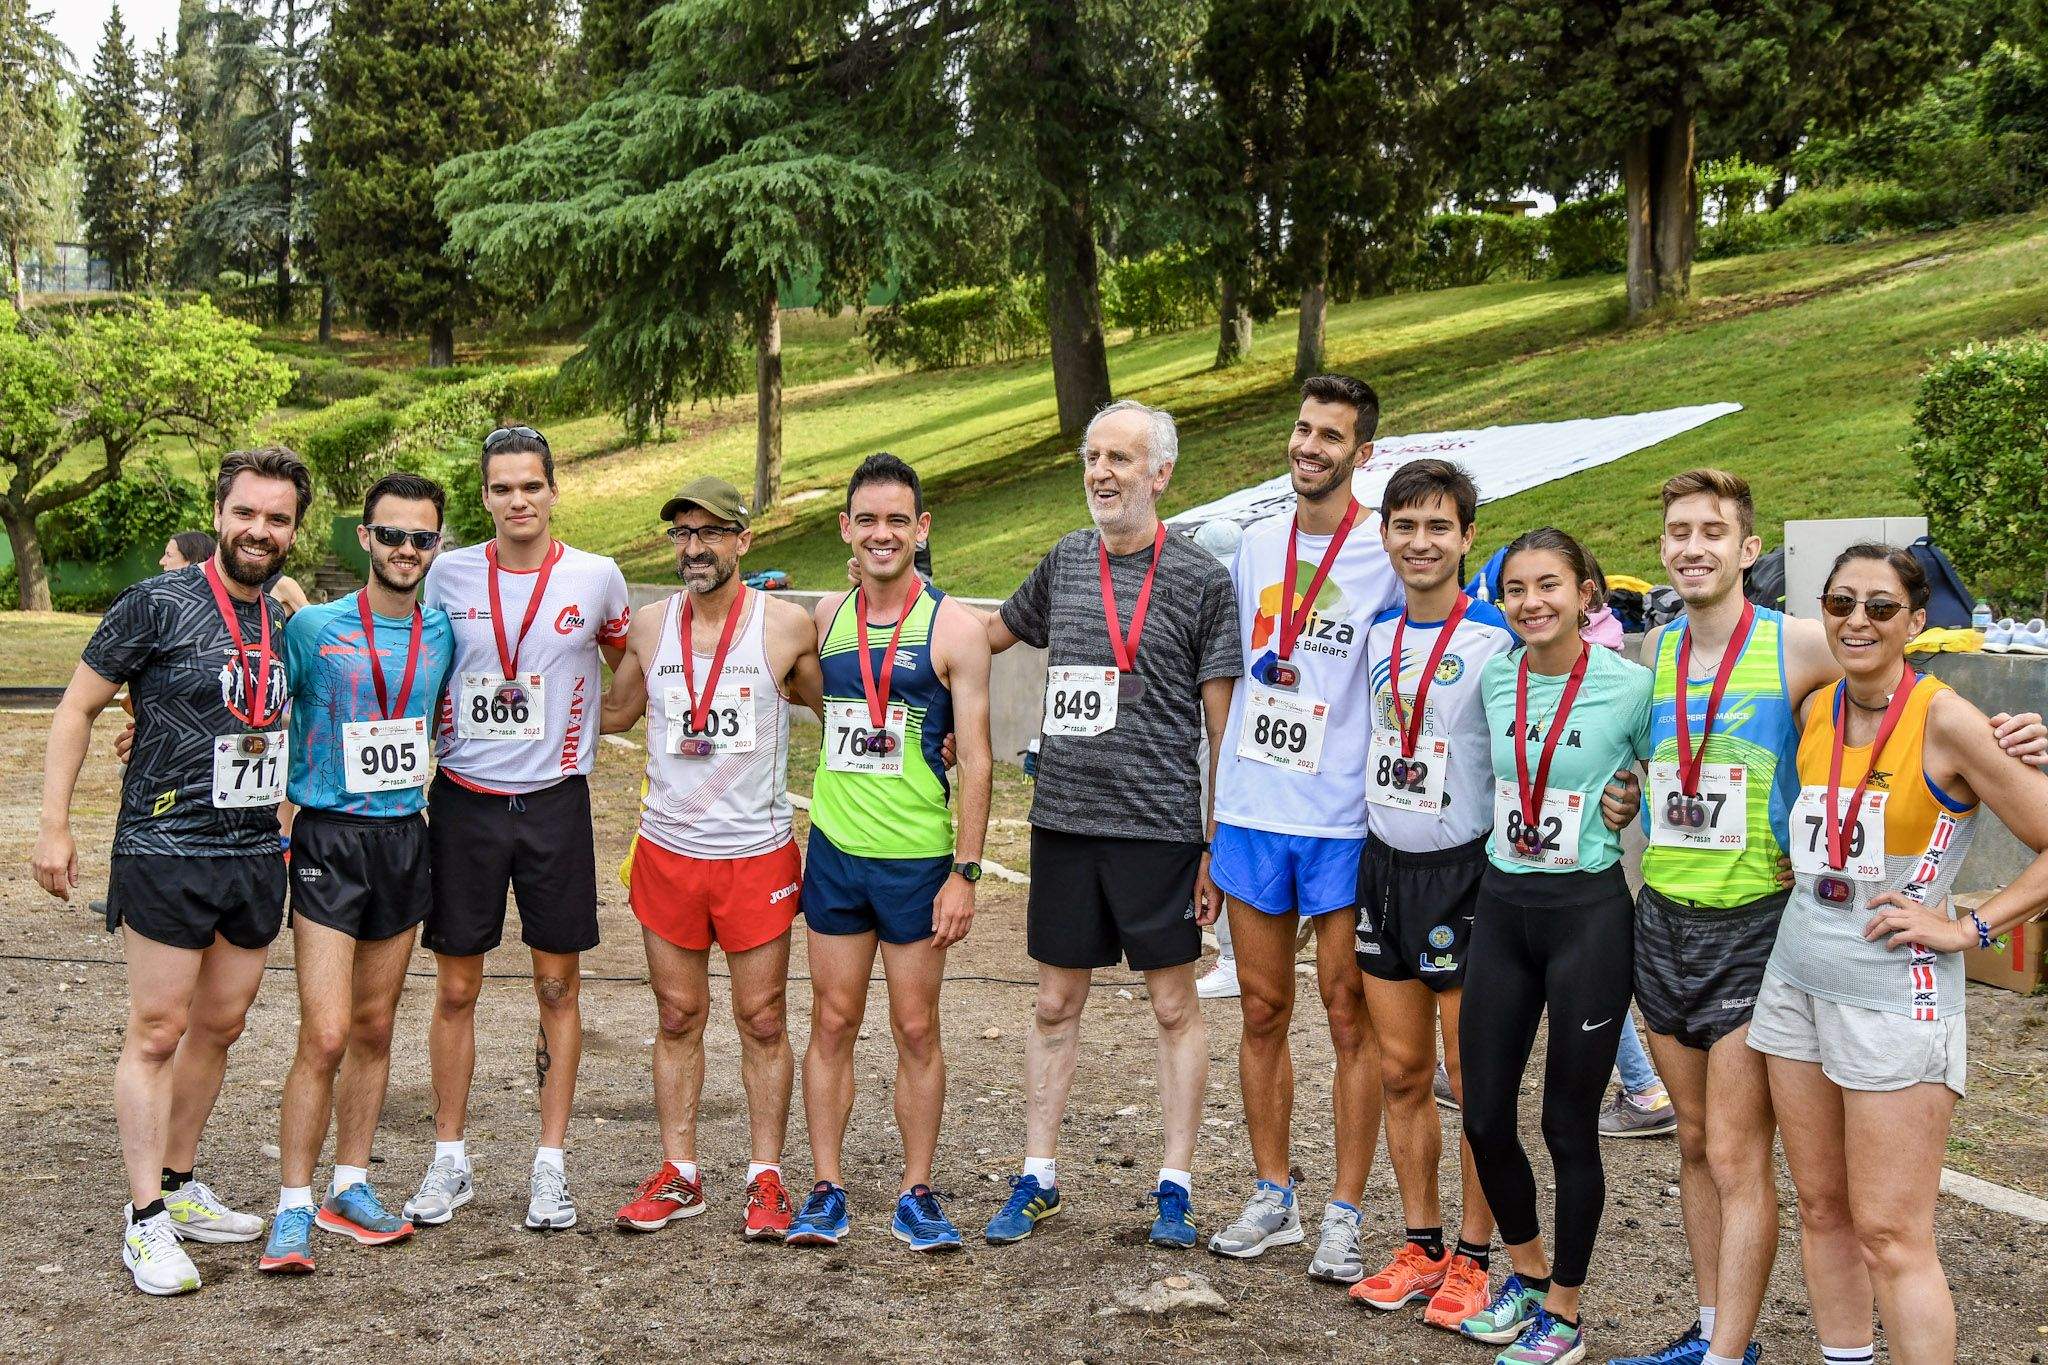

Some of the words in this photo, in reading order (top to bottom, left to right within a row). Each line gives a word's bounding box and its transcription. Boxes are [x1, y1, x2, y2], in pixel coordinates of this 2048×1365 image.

[1303, 640, 1348, 658] Balears
[720, 664, 760, 675] SPAÑA
[471, 694, 529, 723] 866
[1053, 690, 1101, 720] 849
[523, 727, 541, 735] 2023
[1254, 714, 1307, 753] 869
[734, 740, 752, 748] 2023
[837, 726, 889, 758] 764
[360, 742, 416, 775] 905
[881, 763, 899, 771] 2023
[1297, 759, 1315, 769] 2023
[1418, 799, 1437, 809] 2023
[1719, 835, 1741, 843] 2023
[1805, 814, 1866, 859] 79
[1554, 856, 1574, 865] 2023
[1857, 865, 1880, 875] 2023
